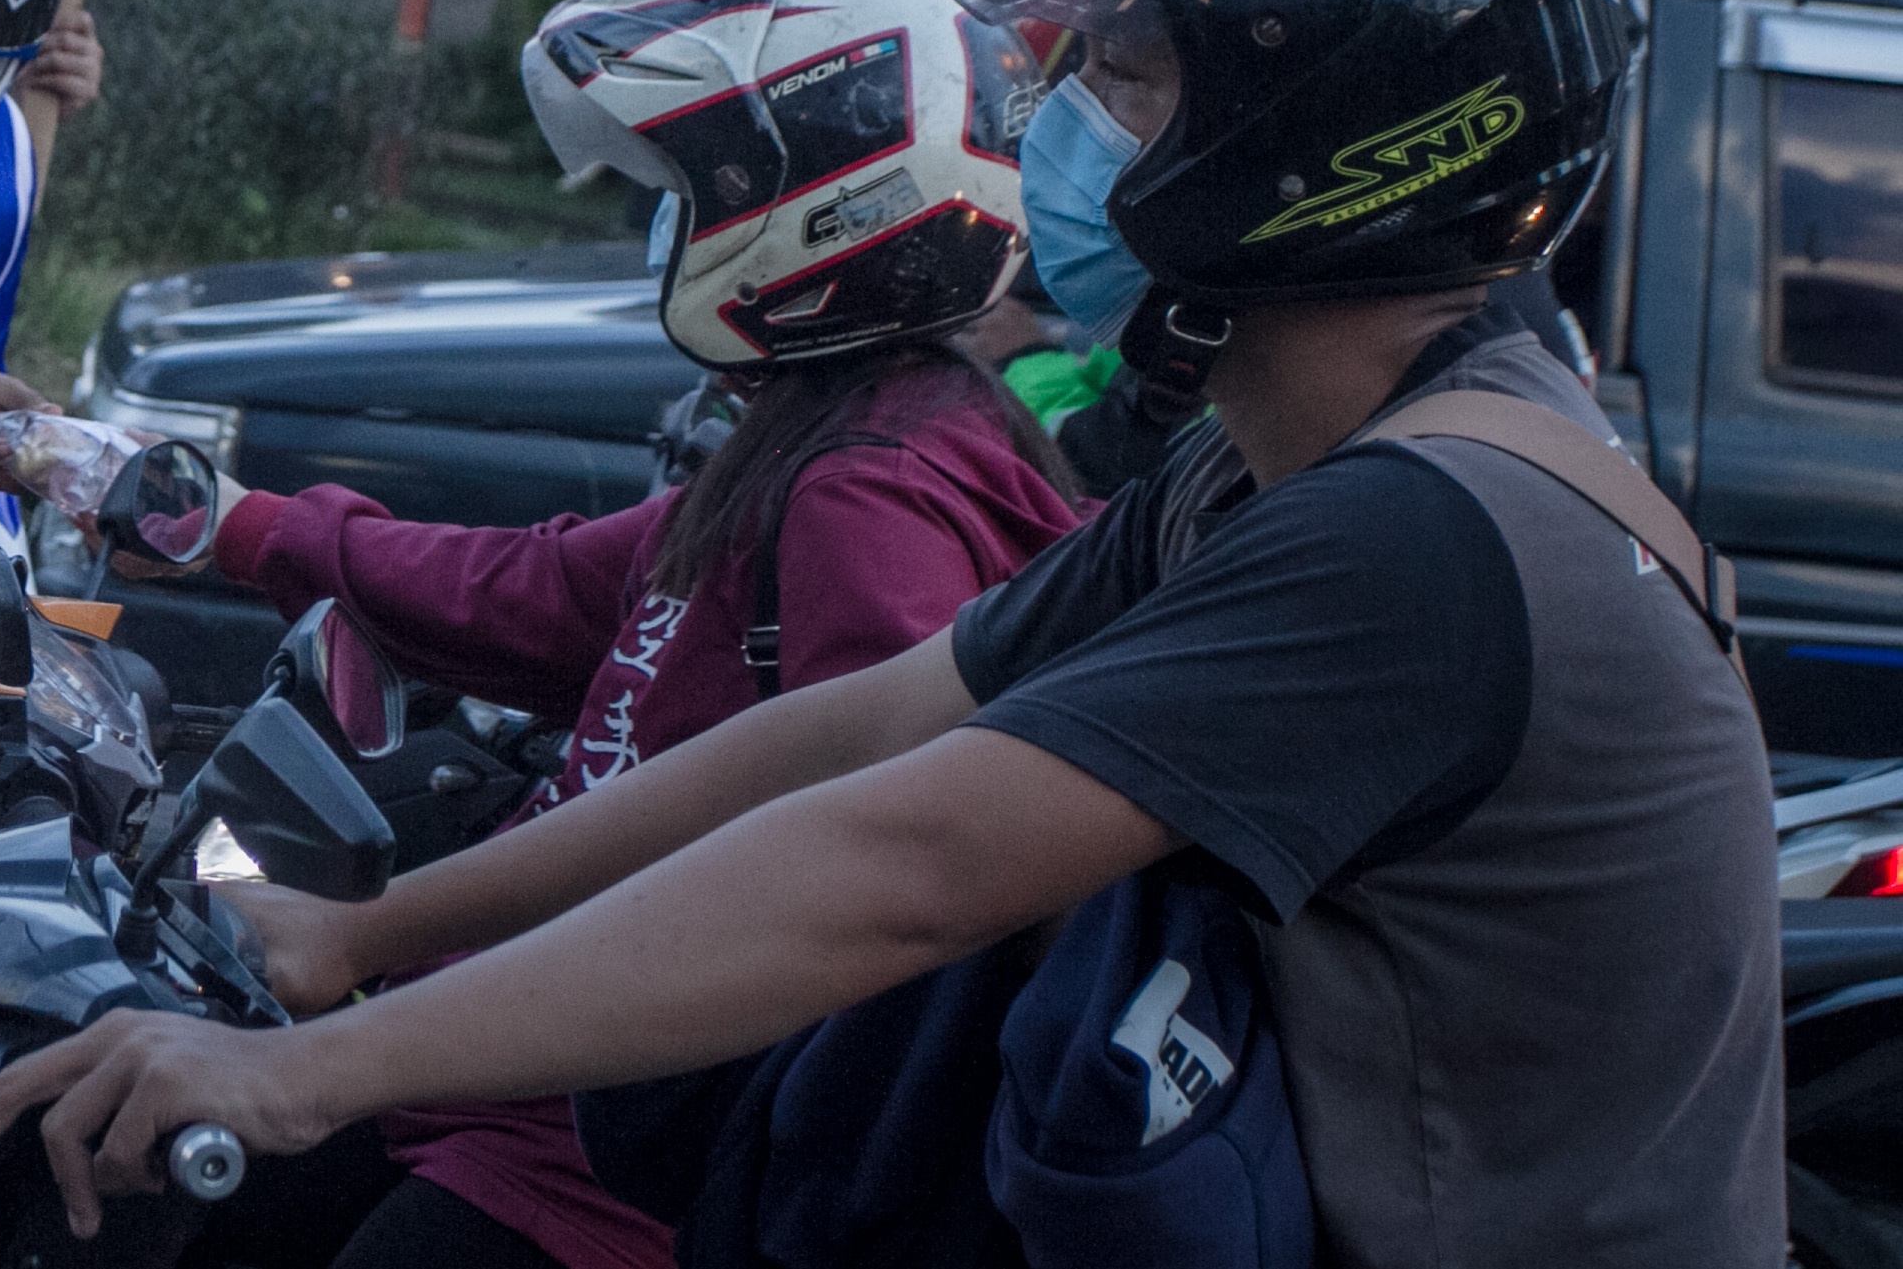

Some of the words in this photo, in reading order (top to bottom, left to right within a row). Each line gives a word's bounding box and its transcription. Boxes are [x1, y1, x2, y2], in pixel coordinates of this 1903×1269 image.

[768, 56, 847, 101] VENOM
[1321, 184, 1413, 224] FACTORY
[1420, 148, 1491, 187] RACING
